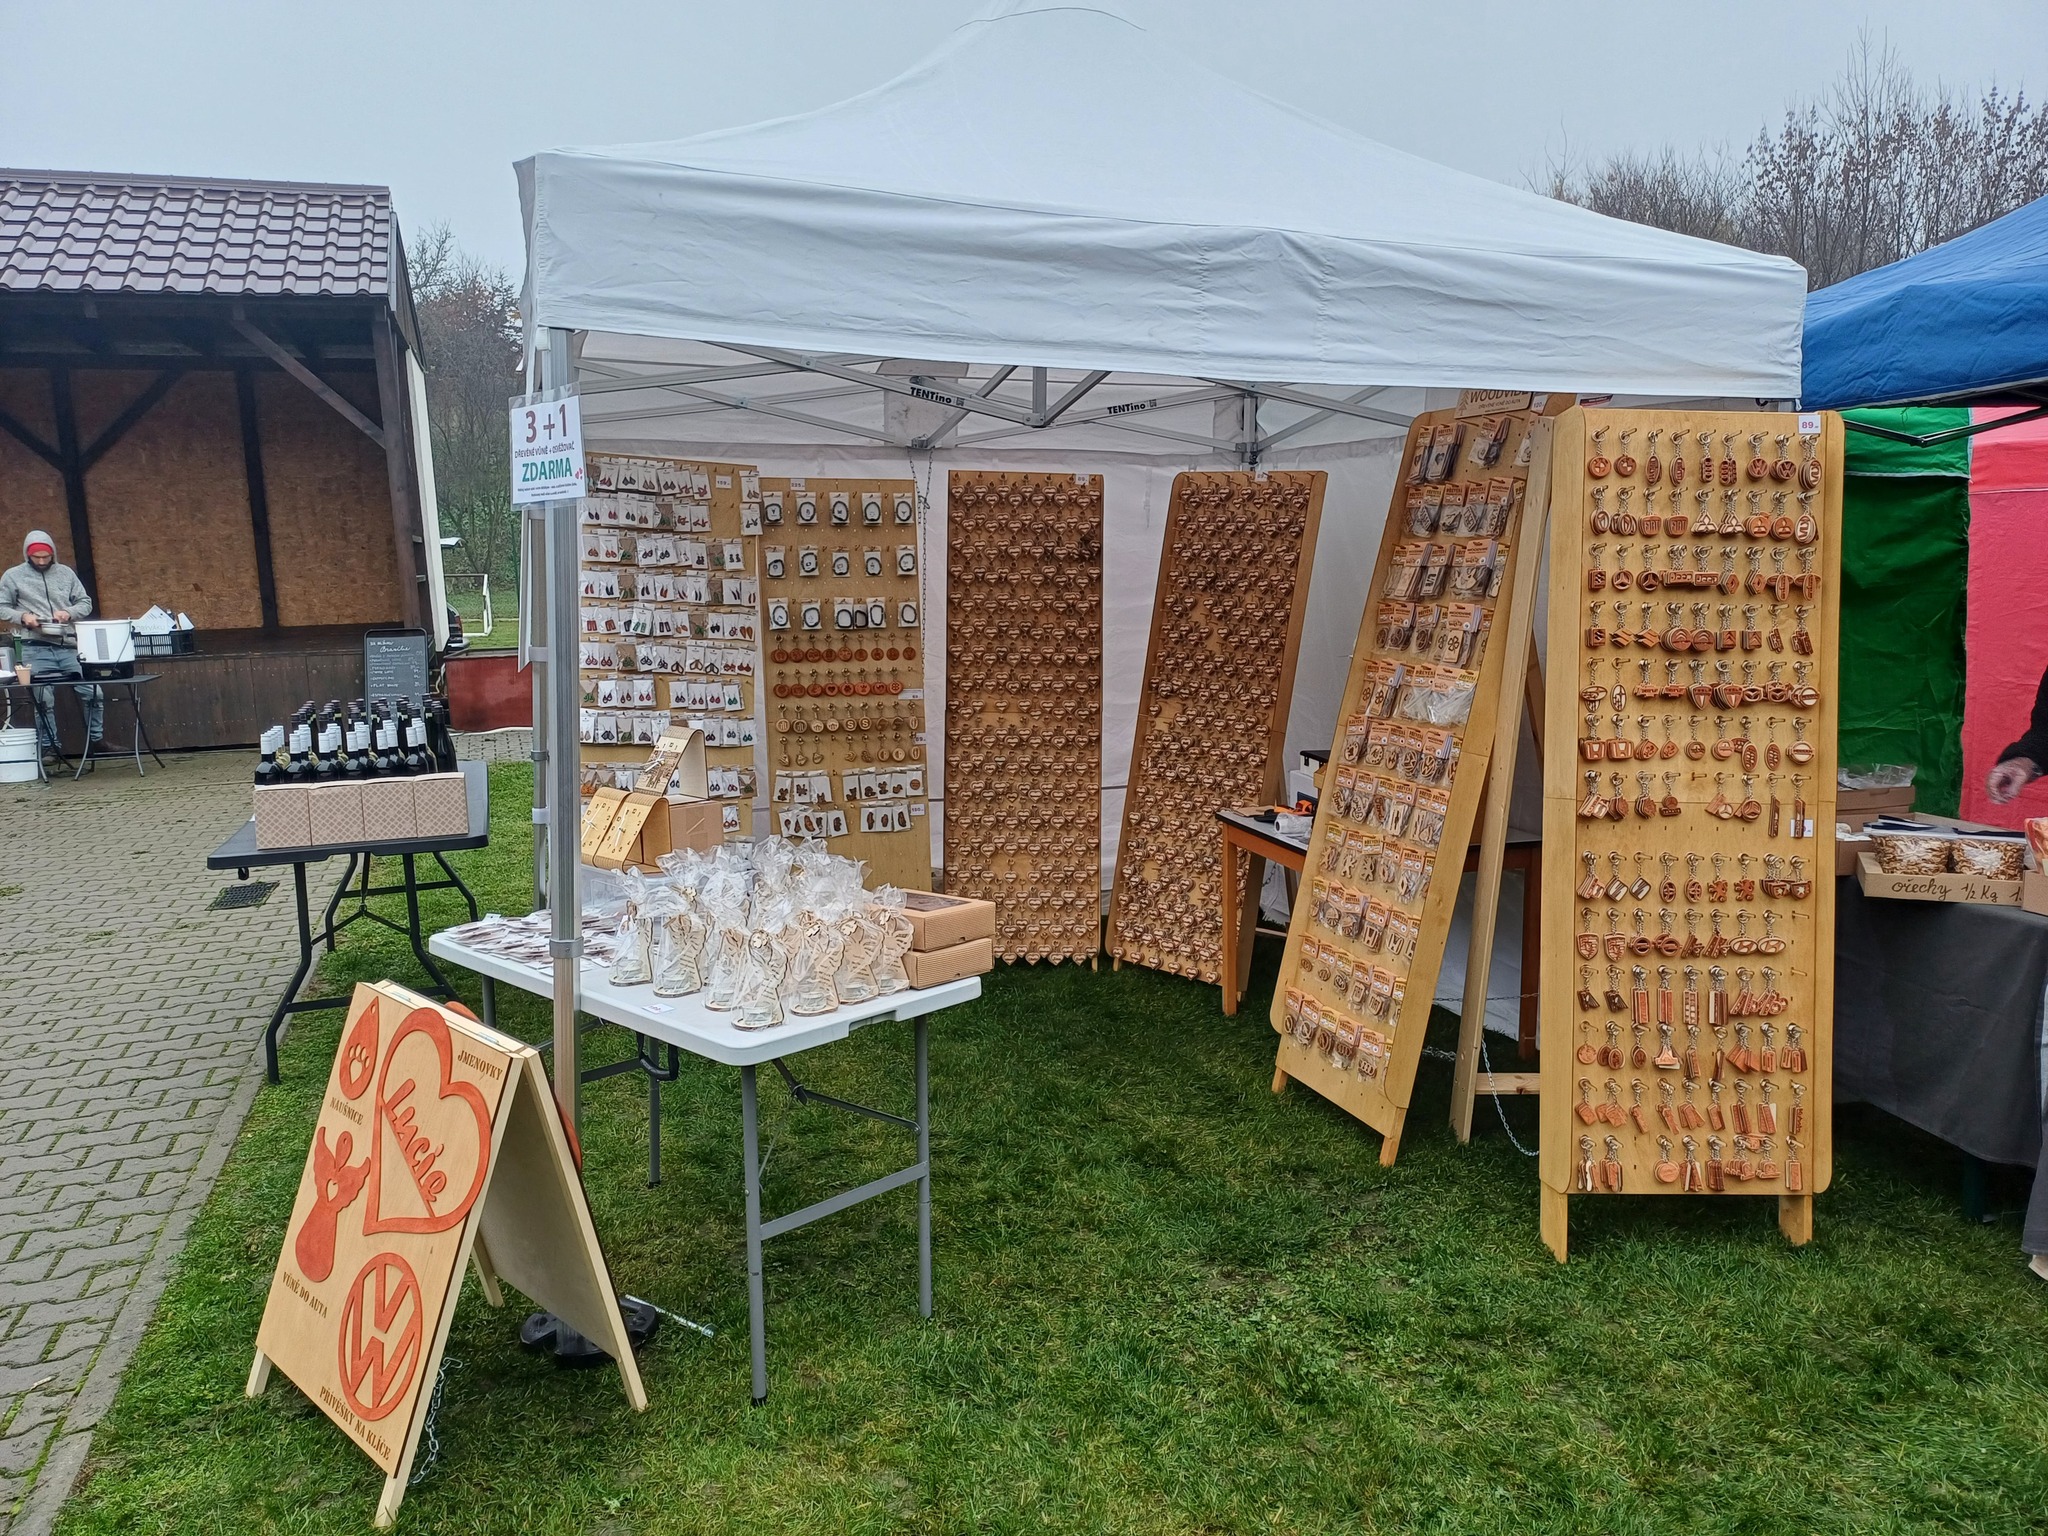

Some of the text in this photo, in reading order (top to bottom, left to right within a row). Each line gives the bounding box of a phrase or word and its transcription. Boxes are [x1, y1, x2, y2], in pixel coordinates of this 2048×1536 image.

[910, 386, 952, 404] TENTino
[1107, 402, 1146, 414] TENTino
[522, 457, 572, 483] ZDARMA
[1696, 574, 1718, 586] Jeep
[1892, 878, 1952, 901] ořechy
[457, 1050, 503, 1081] JMENOVKY
[330, 1097, 364, 1126] NAUŠNICE
[385, 1078, 447, 1203] Lucie
[283, 1271, 328, 1319] VŮNĚ DO AUTA
[319, 1386, 392, 1461] PŘÍVĚŠKY NA KLÍČE
